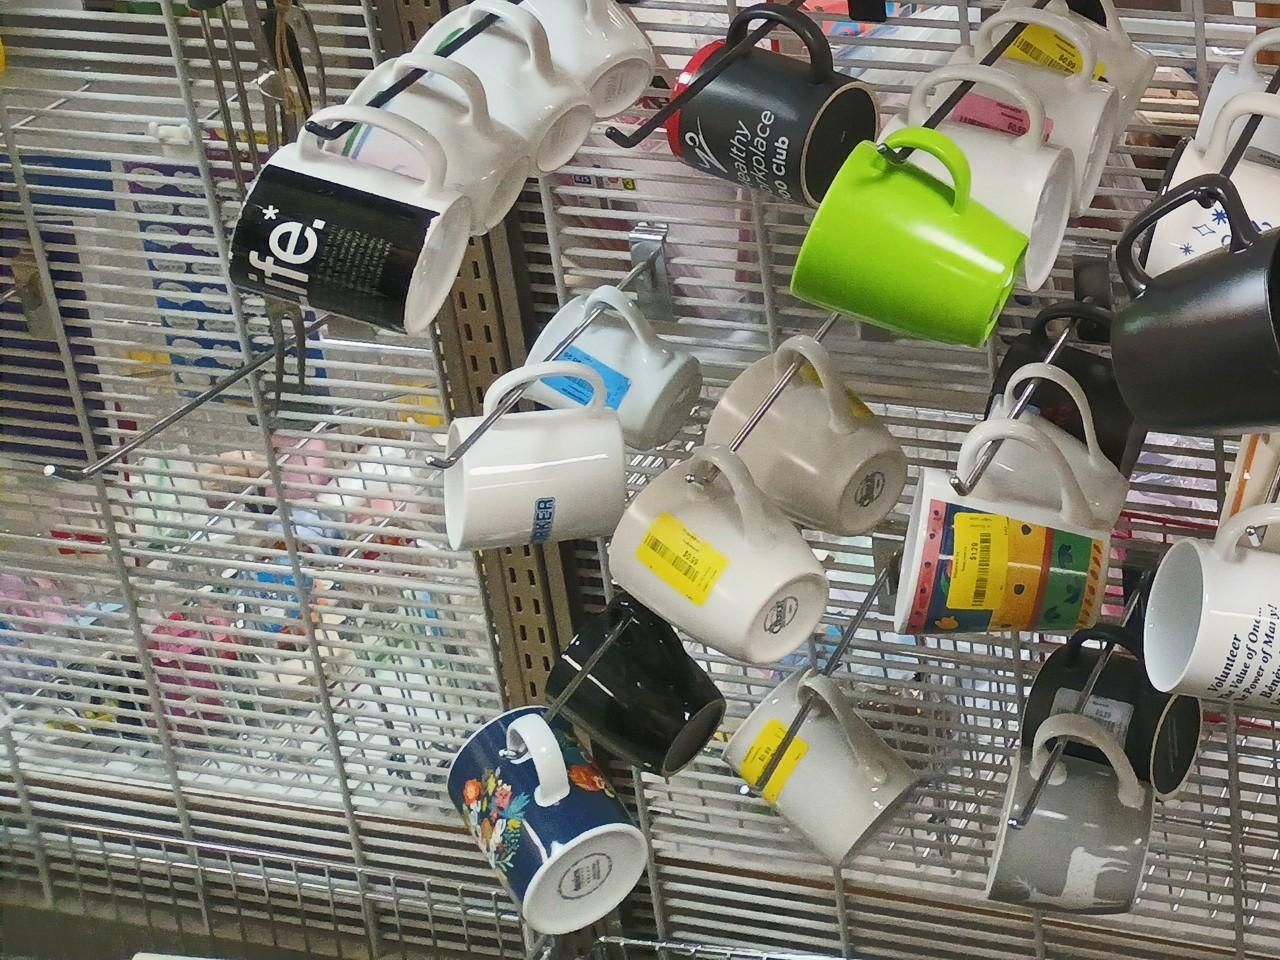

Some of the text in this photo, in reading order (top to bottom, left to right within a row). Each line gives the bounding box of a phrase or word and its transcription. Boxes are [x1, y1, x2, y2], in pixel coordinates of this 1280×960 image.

[751, 110, 775, 194] orkplace
[772, 136, 789, 177] Club
[1207, 633, 1242, 693] Volunteer
[1229, 661, 1251, 691] Value
[1245, 643, 1258, 660] of
[1243, 664, 1265, 695] Power
[1261, 647, 1273, 664] of
